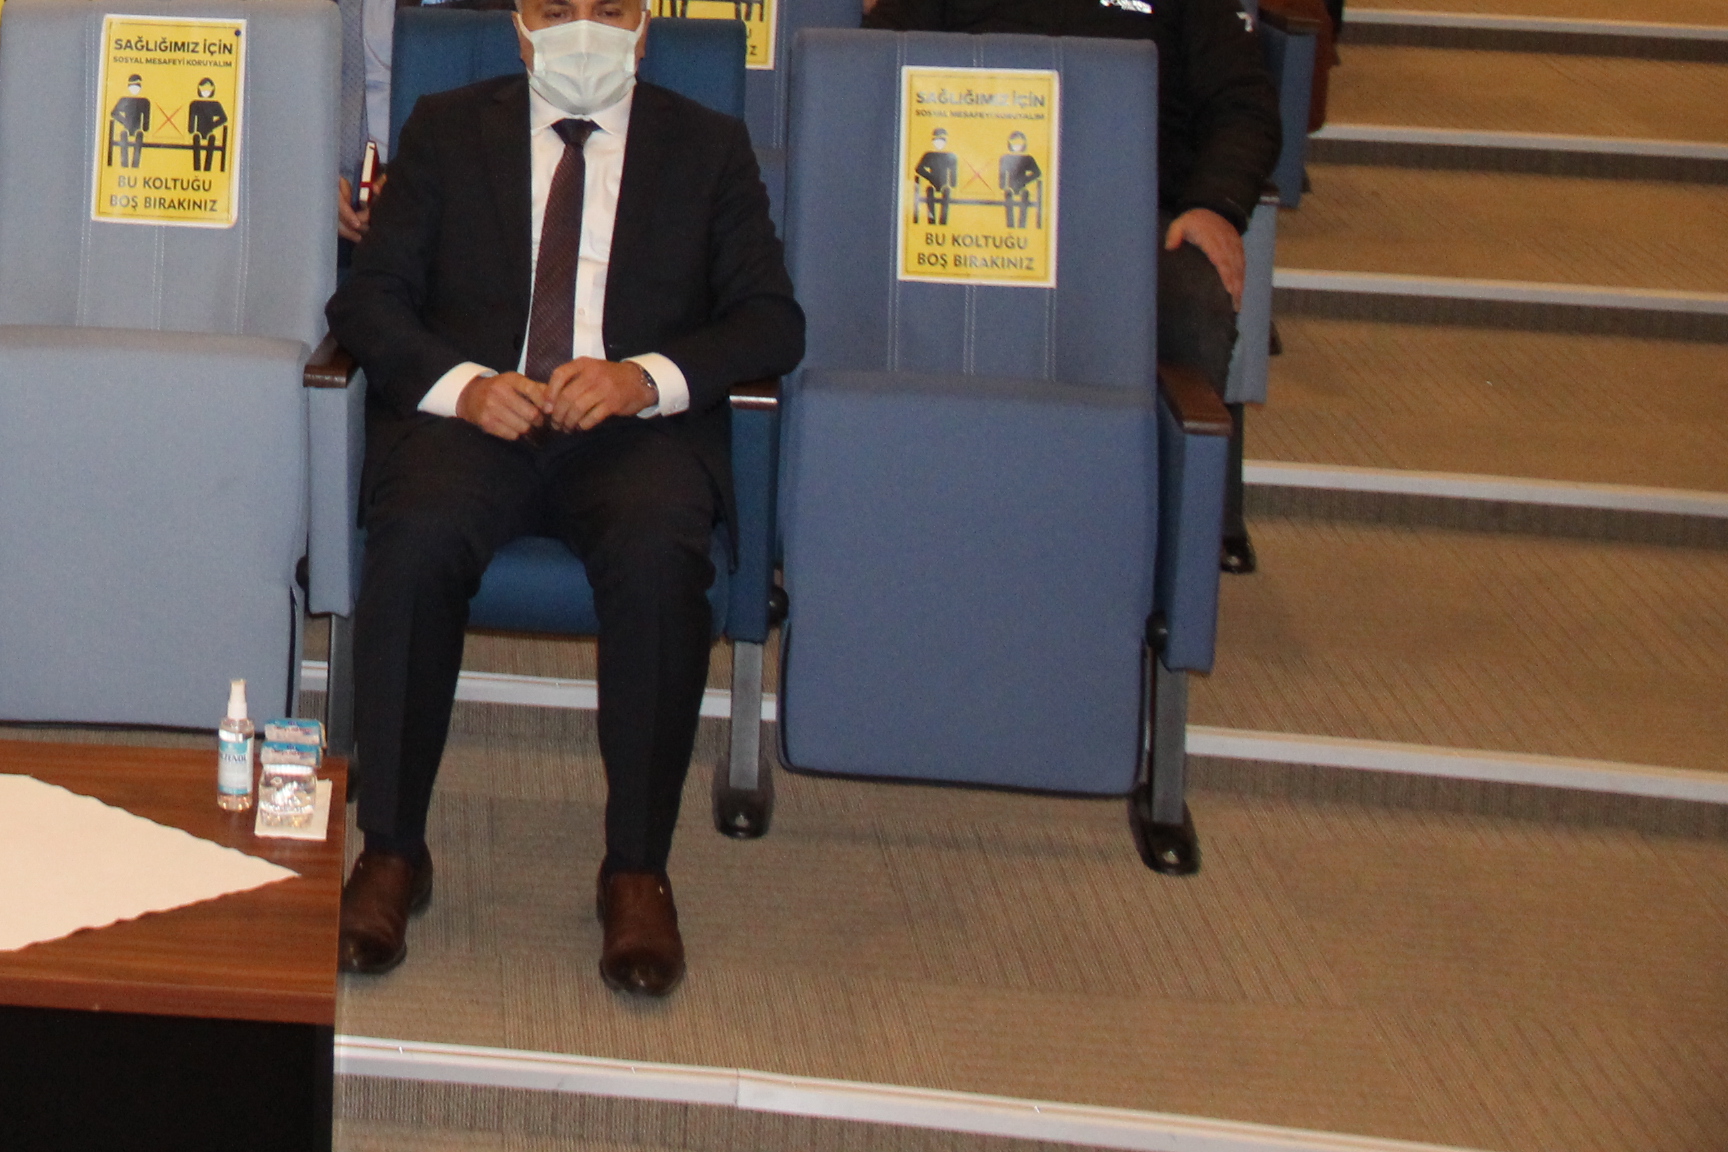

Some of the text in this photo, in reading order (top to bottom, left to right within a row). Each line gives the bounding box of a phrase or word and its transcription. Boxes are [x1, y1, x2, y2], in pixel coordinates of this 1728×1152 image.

[114, 36, 233, 56] SAĞLIĞIMIZ İÇİN
[113, 56, 232, 68] SOSYAL MESAFEYİ KORUYALIM
[916, 88, 1045, 108] SAĞLIĞIMIZ İÇİN
[118, 176, 212, 192] BU KOLTUĞU
[110, 194, 218, 212] BOŞ BIRAKINIZ
[925, 232, 1028, 250] BU KOLTUĞU
[917, 253, 1035, 270] BOŞ BIRAKINIZ
